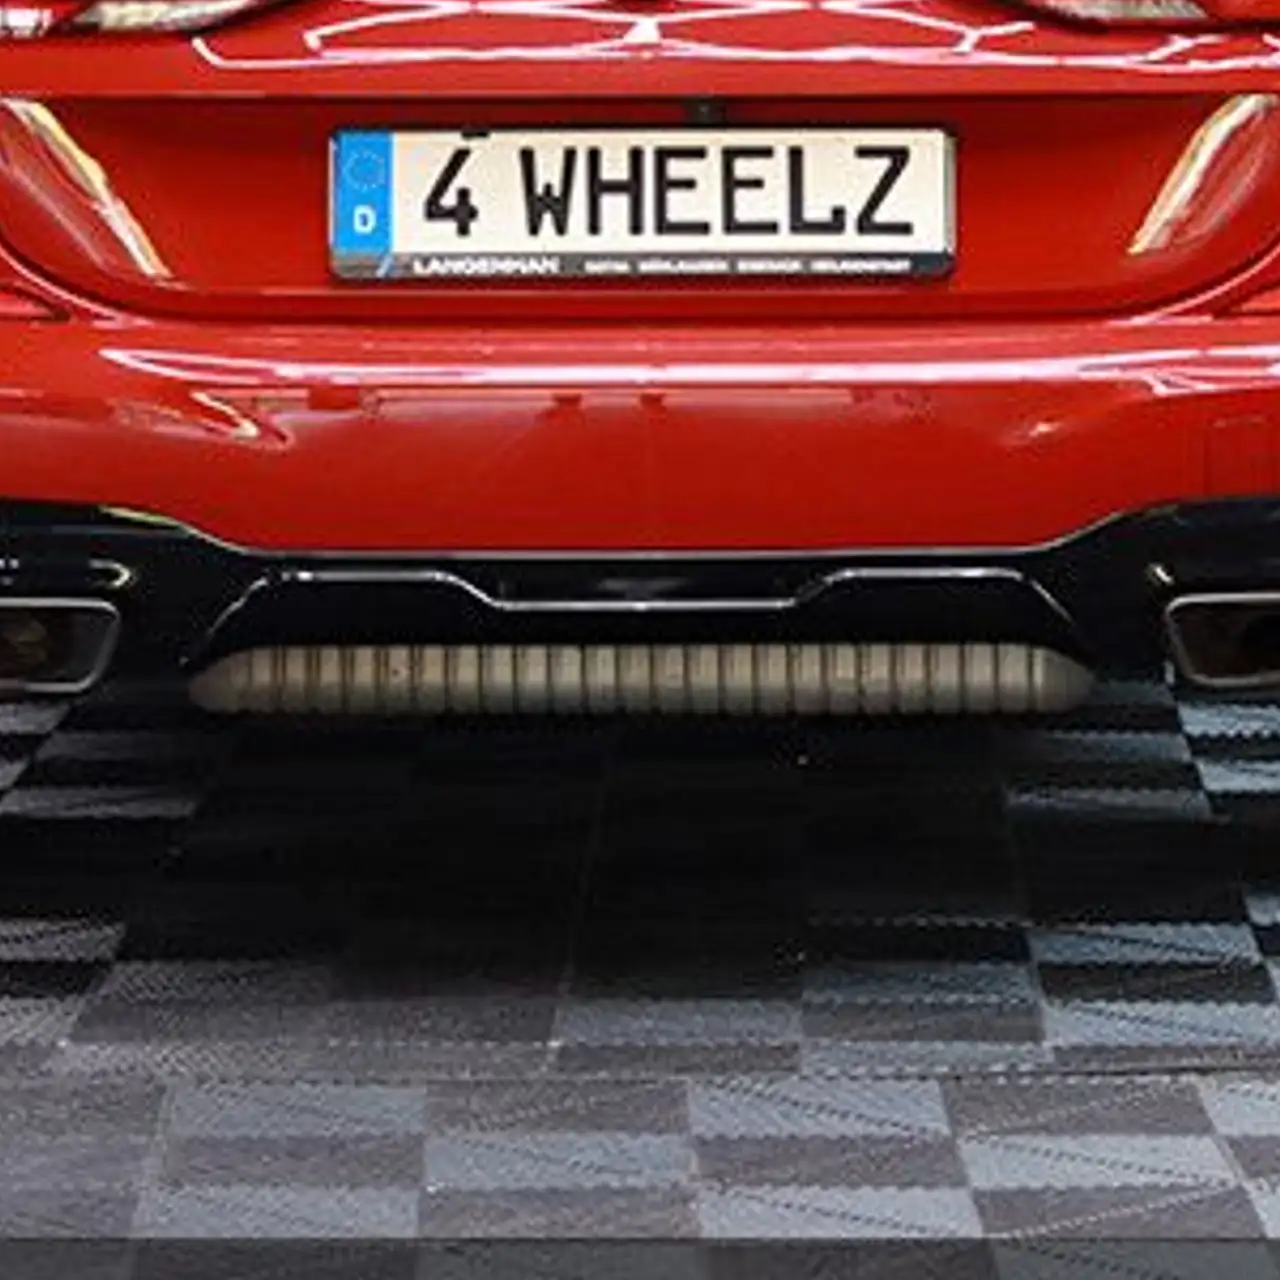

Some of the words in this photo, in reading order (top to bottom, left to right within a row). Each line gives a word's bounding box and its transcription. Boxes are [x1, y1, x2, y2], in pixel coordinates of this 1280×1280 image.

[353, 205, 376, 233] D
[424, 146, 479, 237] 4
[519, 146, 914, 237] WHEELZ
